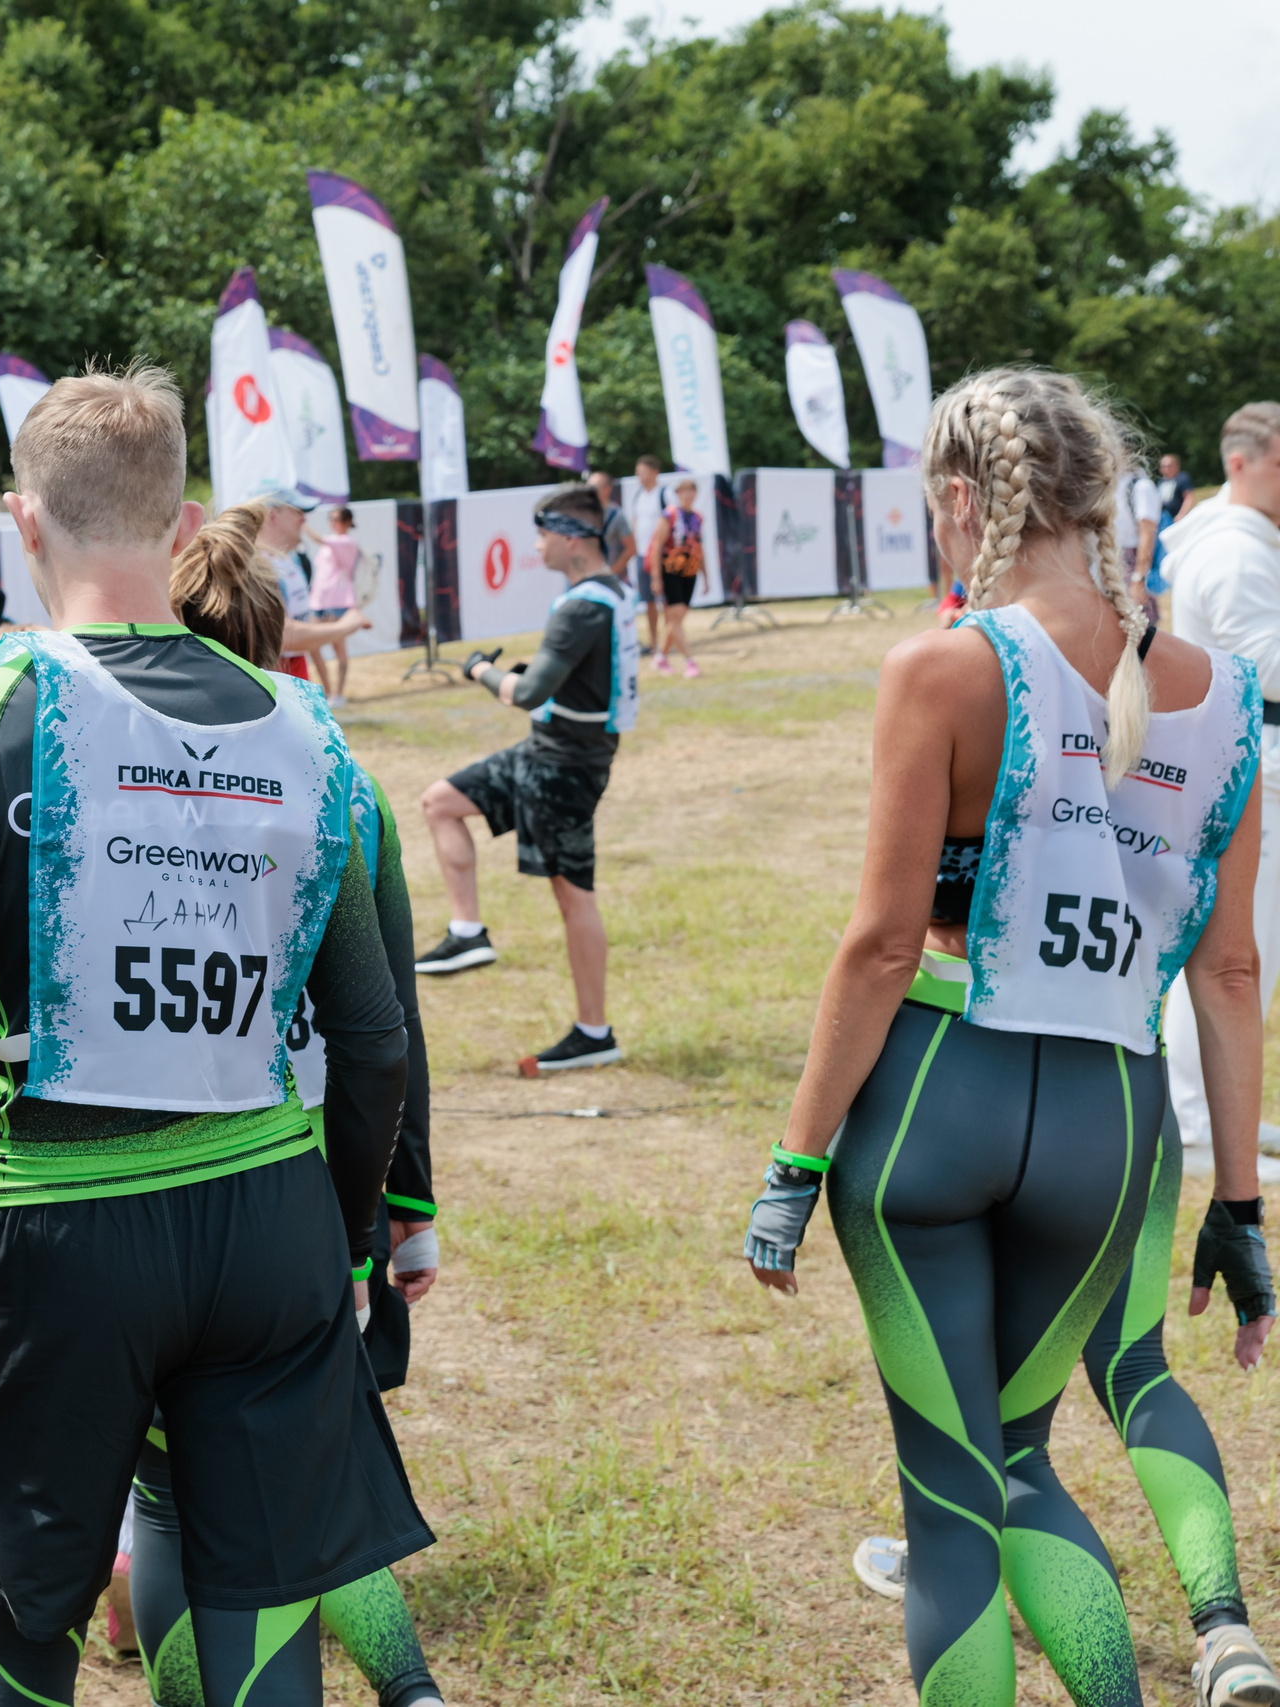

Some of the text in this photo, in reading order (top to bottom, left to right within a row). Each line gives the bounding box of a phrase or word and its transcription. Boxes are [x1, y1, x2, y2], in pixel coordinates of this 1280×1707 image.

[118, 765, 283, 797] ГОНКА ГЕРОЕВ
[106, 836, 263, 882] Greenway
[161, 872, 229, 888] GLOBAL
[123, 890, 237, 935] ДАНИЛ
[113, 945, 268, 1037] 5597
